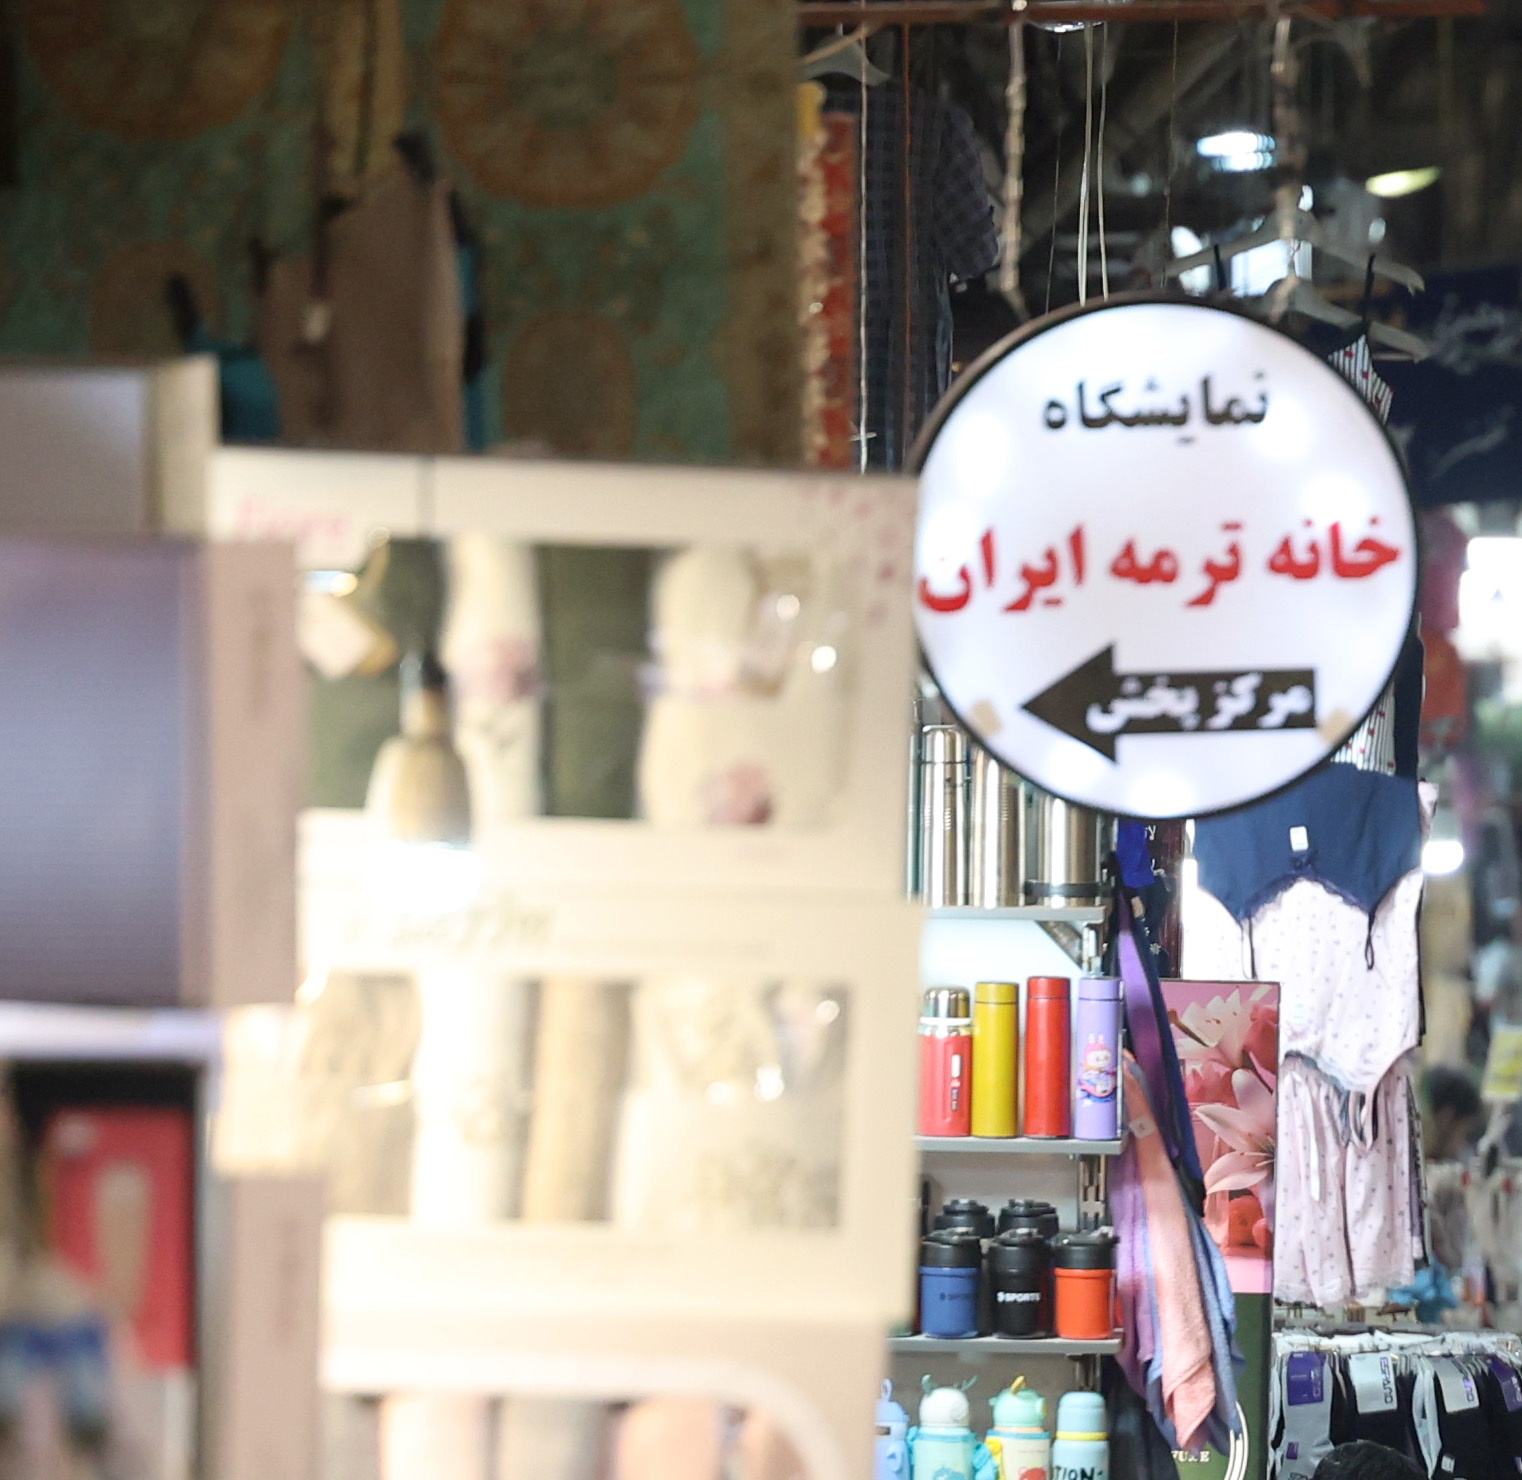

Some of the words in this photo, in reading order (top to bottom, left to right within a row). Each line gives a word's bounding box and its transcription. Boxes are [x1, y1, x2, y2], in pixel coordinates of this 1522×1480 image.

[917, 521, 1089, 613] ایران
[1107, 520, 1245, 609] ترمه
[1267, 516, 1405, 582] خانه
[1085, 674, 1200, 735] پخش
[1204, 671, 1314, 731] مرکز
